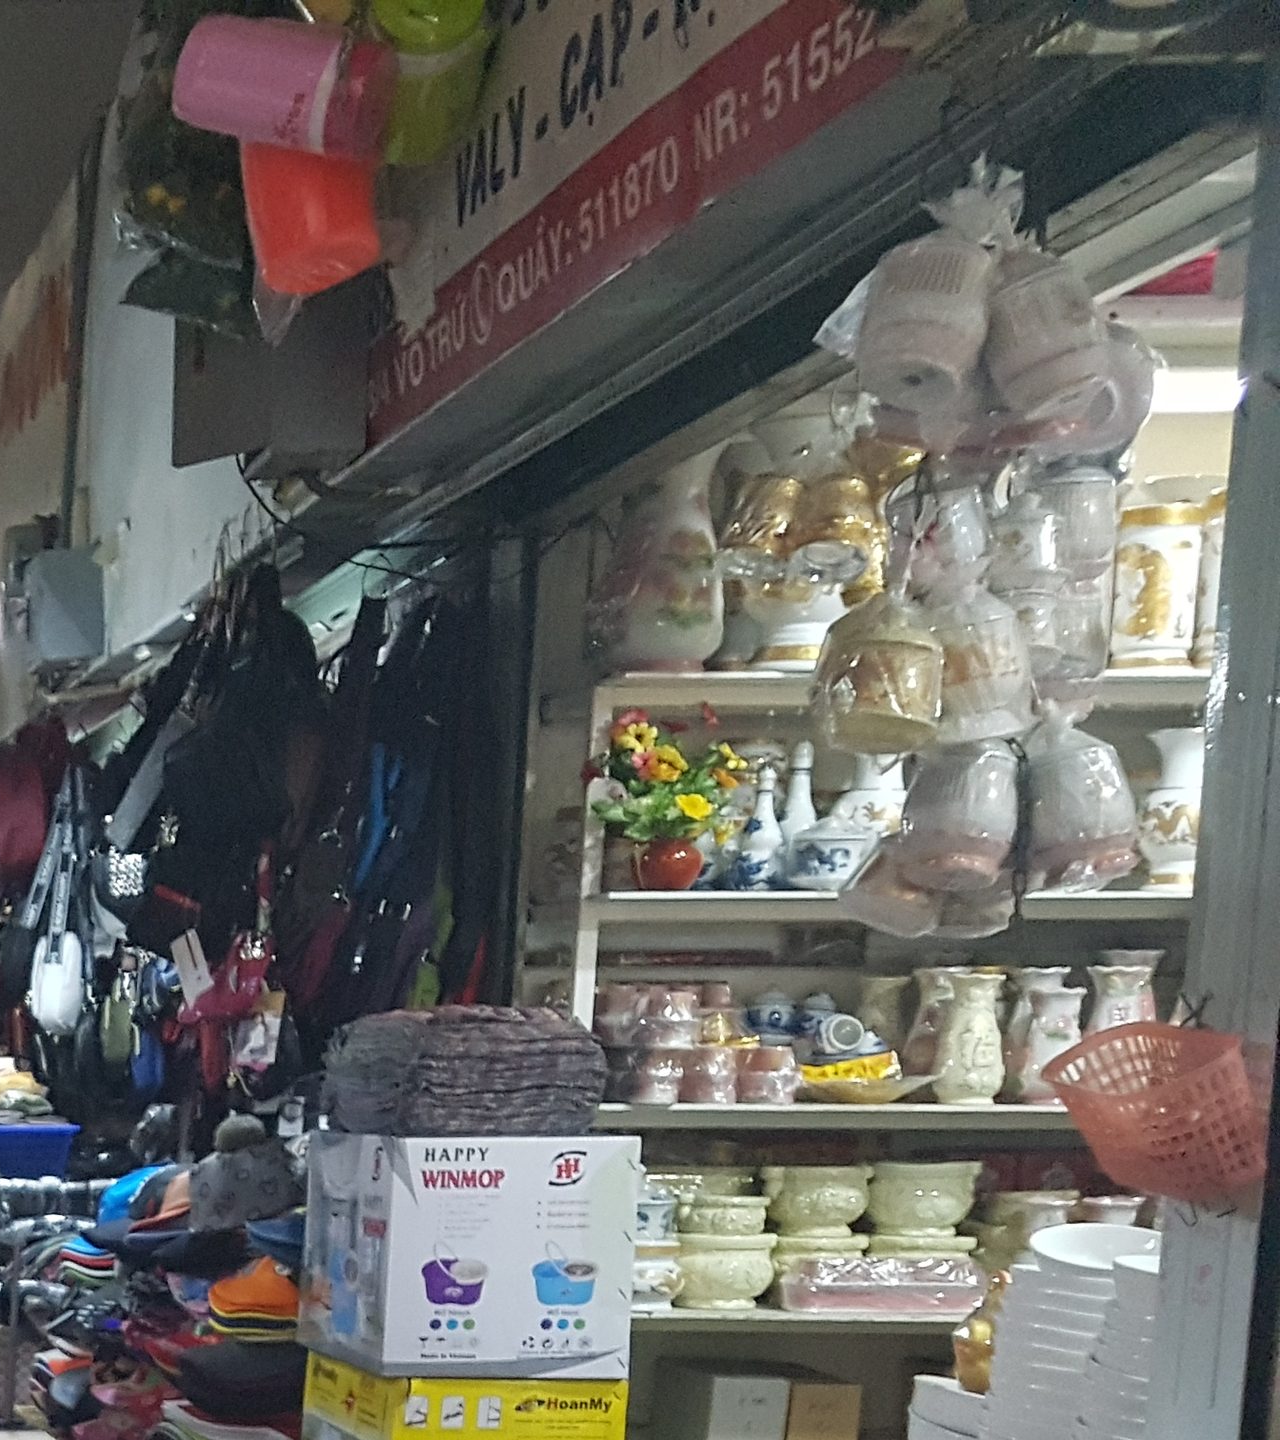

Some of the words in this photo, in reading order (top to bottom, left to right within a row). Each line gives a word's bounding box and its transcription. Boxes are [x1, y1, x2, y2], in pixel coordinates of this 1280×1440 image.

[456, 86, 526, 228] VALY
[577, 136, 680, 254] 511870
[421, 1169, 506, 1189] WINMOP
[423, 1148, 489, 1162] HAPPY
